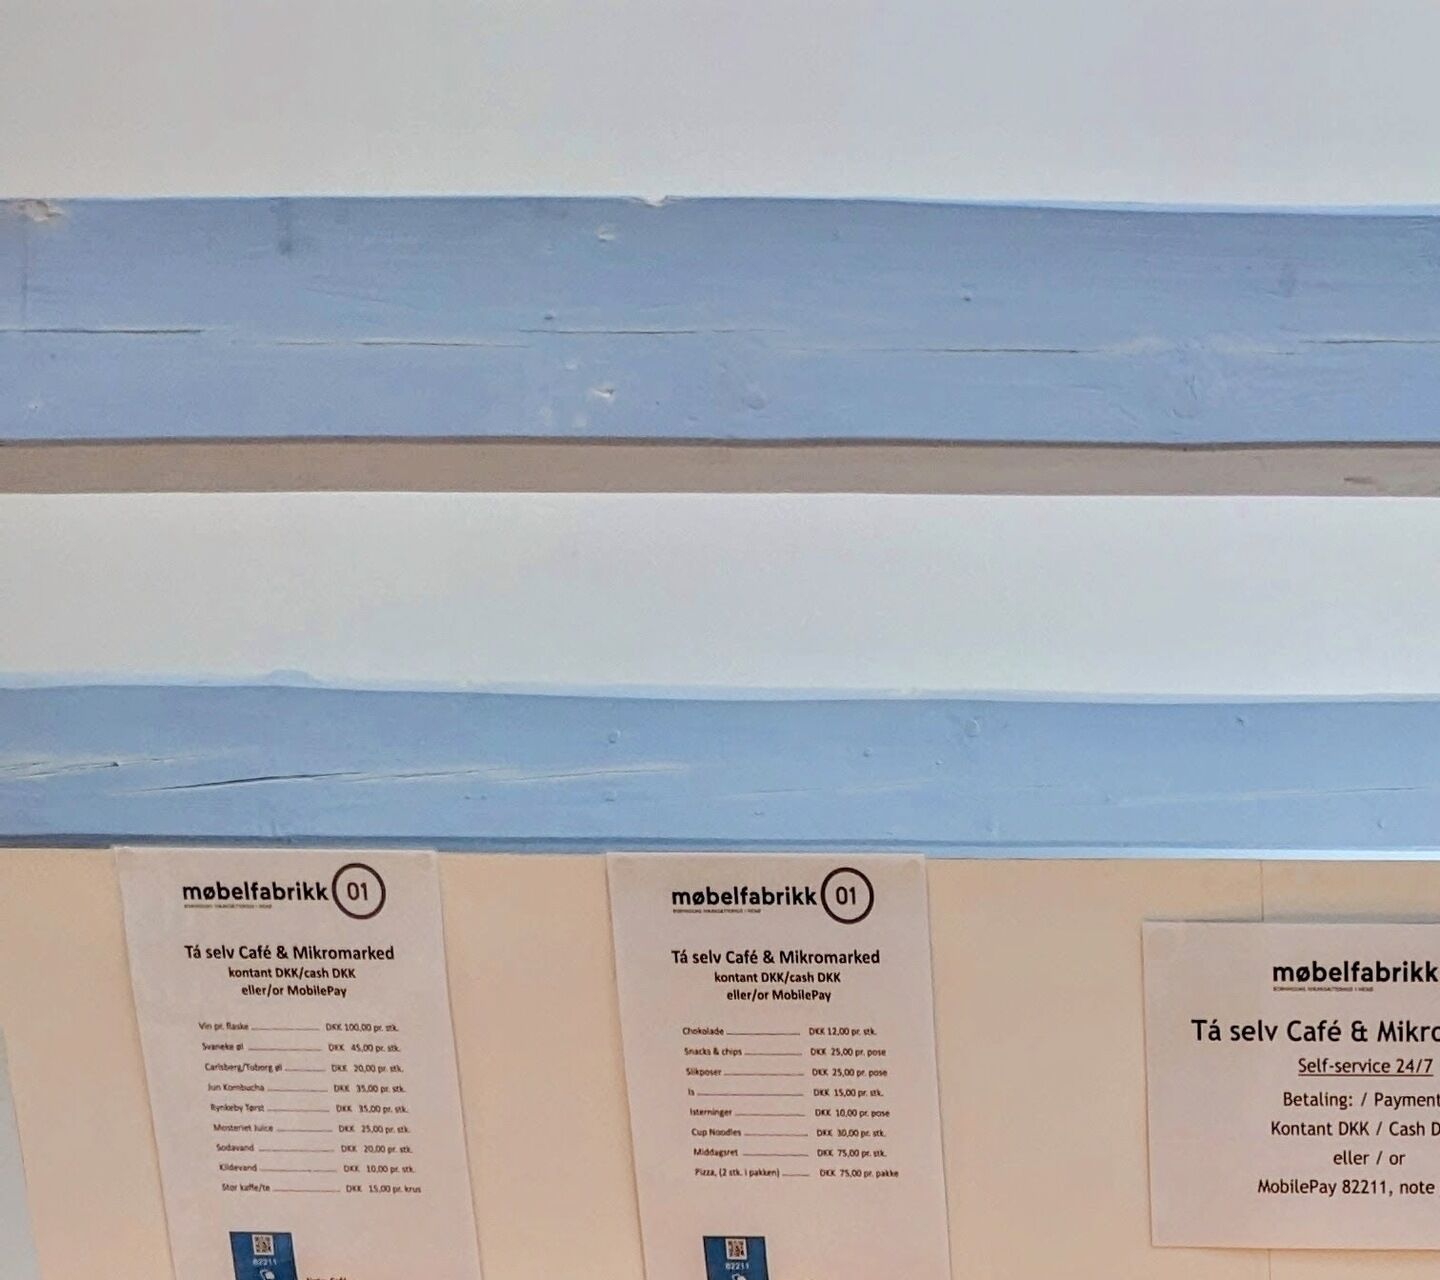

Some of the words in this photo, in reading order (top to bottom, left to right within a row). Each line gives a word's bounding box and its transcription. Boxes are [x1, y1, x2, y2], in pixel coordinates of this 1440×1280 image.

[182, 880, 329, 901] møbelfabrikk
[346, 880, 368, 901] 01
[672, 886, 817, 906] møbelfabrikk
[836, 886, 857, 905] 01
[205, 946, 234, 960] selv
[239, 946, 272, 960] Café
[276, 947, 289, 960] &
[293, 946, 394, 960] Mikromarked
[692, 950, 721, 964] selv
[726, 949, 759, 964] Café
[763, 951, 775, 964] &
[779, 950, 880, 964] Mikromarked
[229, 968, 272, 979] kontant
[275, 968, 329, 979] DKK/cash
[332, 968, 356, 979] DKK
[714, 972, 758, 983] kontant
[761, 972, 815, 984] DKK/cash
[818, 972, 840, 983] DKK
[1272, 961, 1438, 982] møbelfabrikk
[242, 985, 284, 997] eller/or
[287, 985, 347, 997] MobilePay
[726, 990, 768, 1001] eller/or
[772, 990, 831, 1002] MobilePay
[683, 1027, 724, 1035] Chokolade
[1230, 1020, 1277, 1041] selv
[1287, 1019, 1342, 1042] Café
[1351, 1021, 1368, 1041] &
[1298, 1059, 1390, 1074] Self-service
[1396, 1059, 1433, 1074] 24/7
[1283, 1092, 1353, 1109] Betaling:
[1361, 1093, 1368, 1107] /
[1271, 1121, 1332, 1136] Kontant
[1338, 1122, 1369, 1136] DKK
[1376, 1121, 1382, 1136] /
[1389, 1122, 1426, 1137] Cash
[1333, 1150, 1369, 1165] eller
[1376, 1150, 1382, 1165] /
[1389, 1153, 1406, 1165] or
[1258, 1179, 1337, 1197] MobilePay
[1342, 1180, 1393, 1196] 82211,
[1400, 1182, 1435, 1195] note
